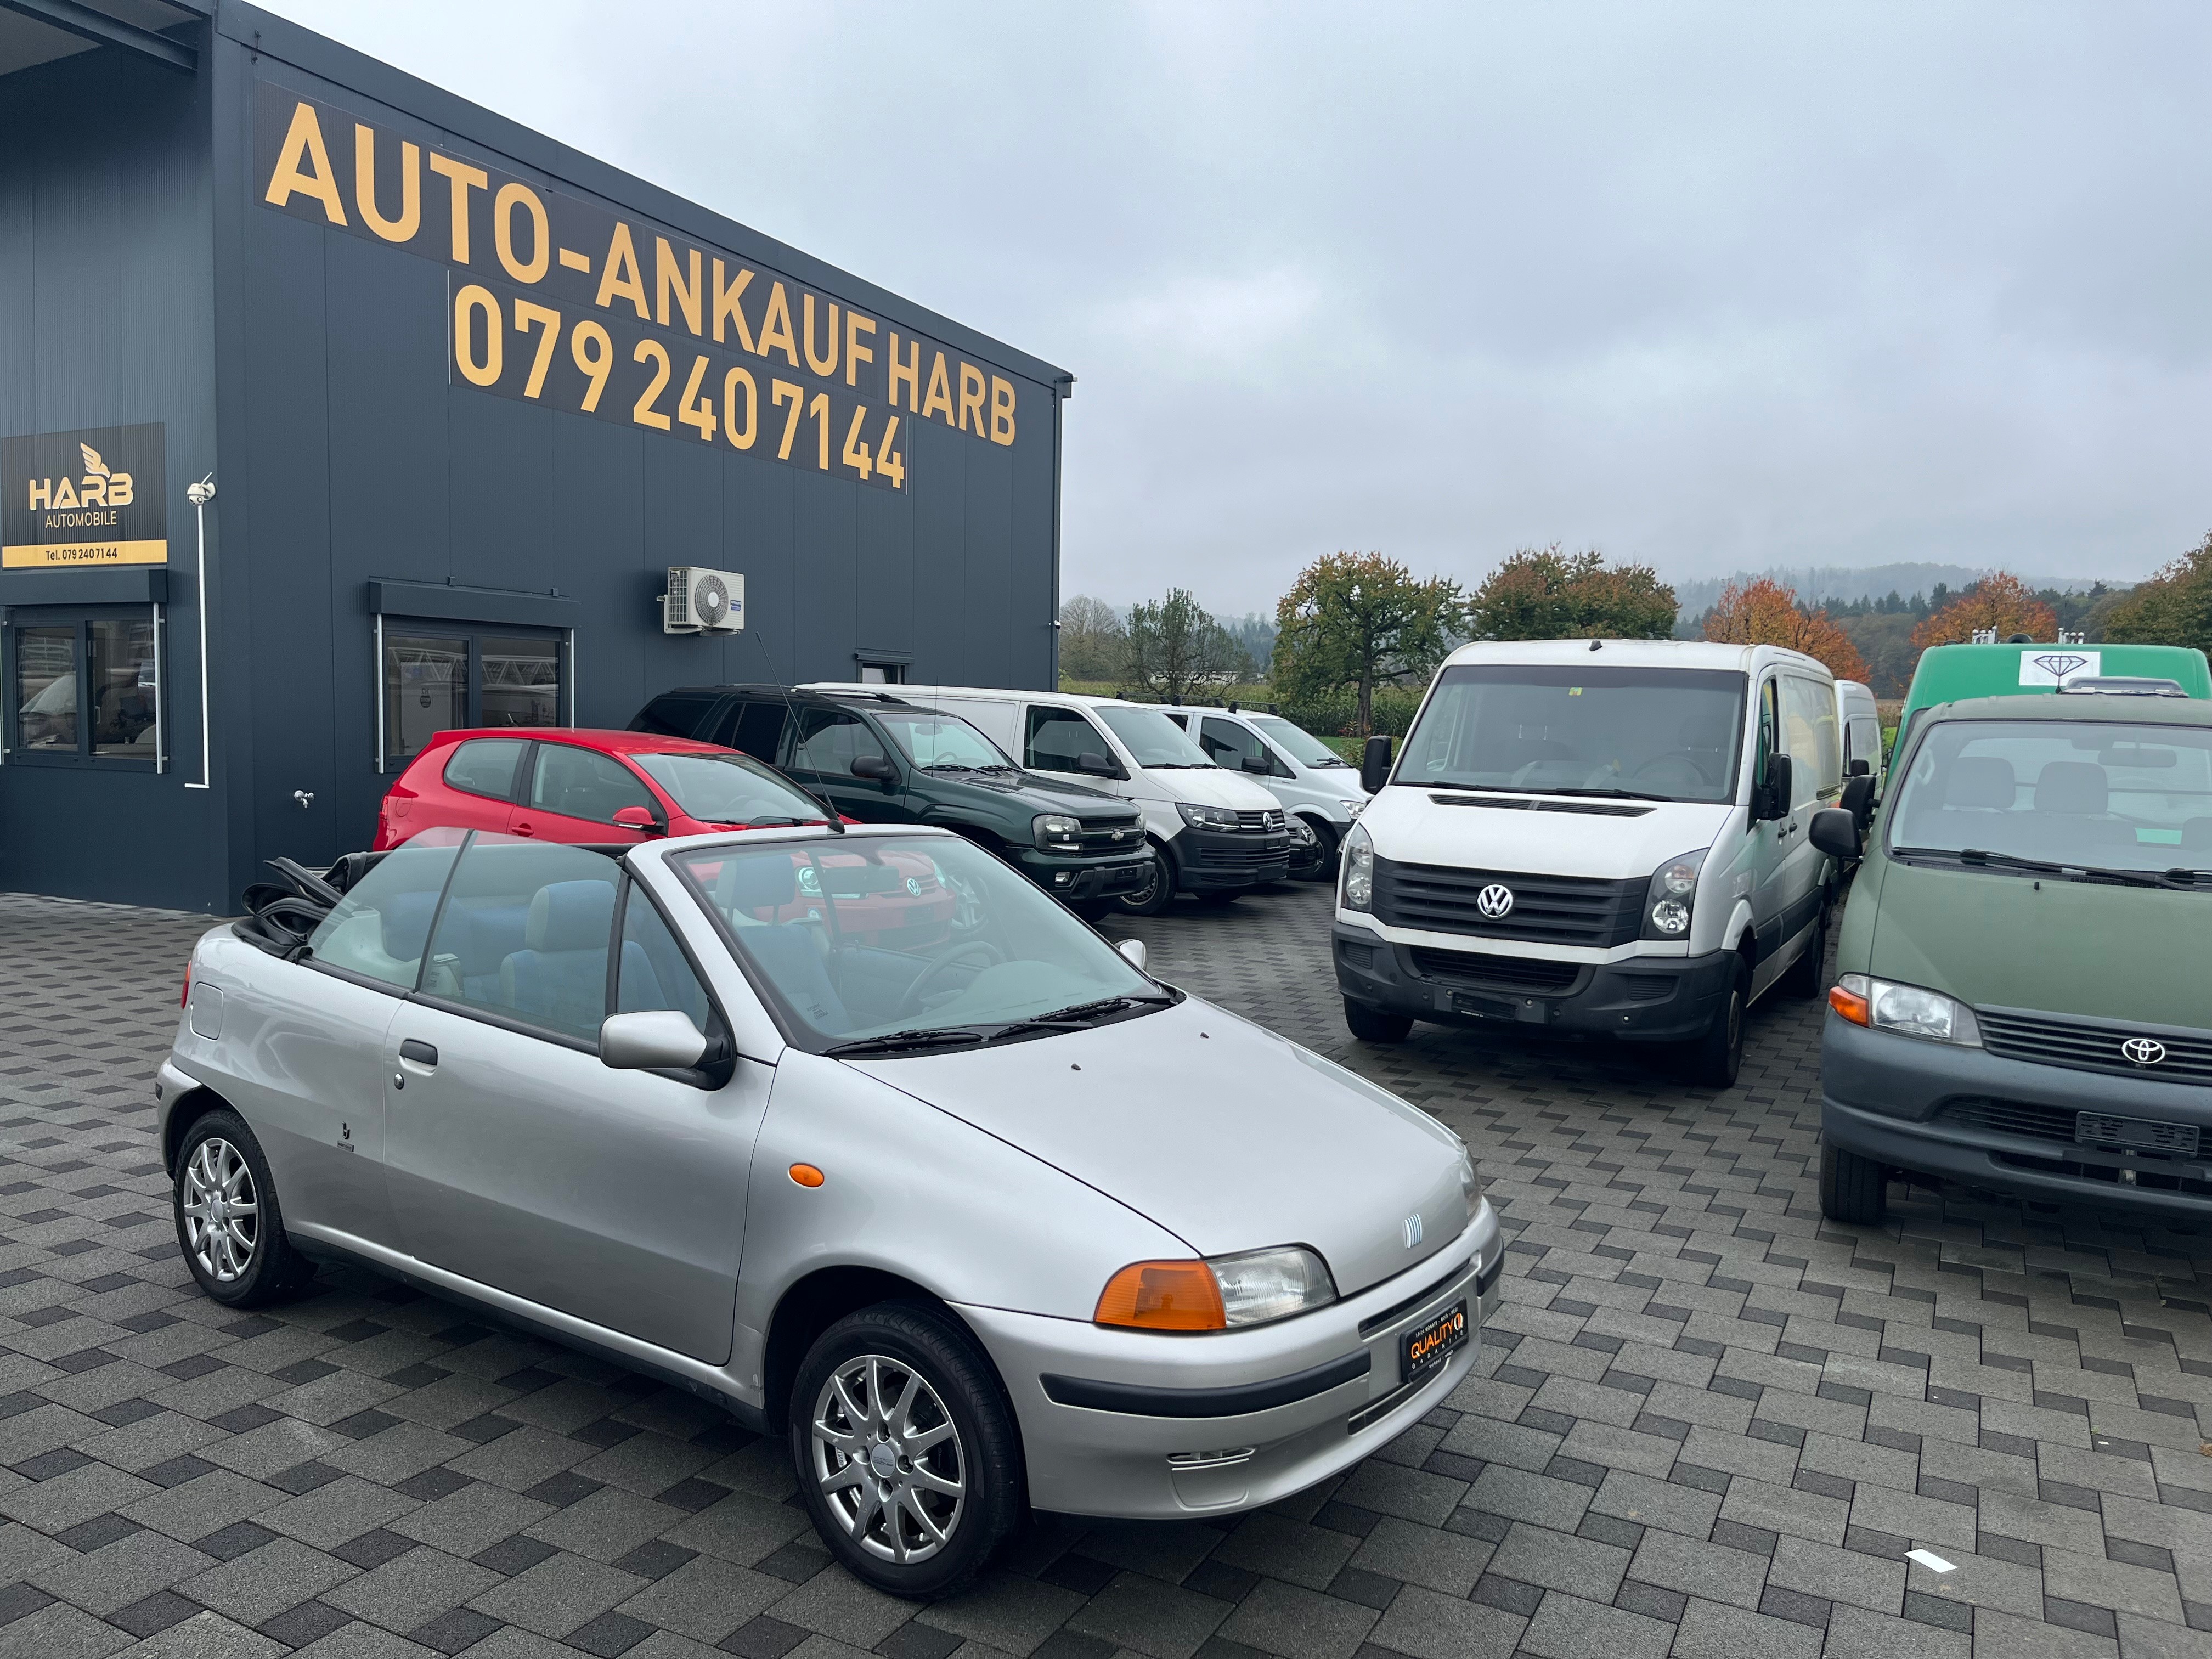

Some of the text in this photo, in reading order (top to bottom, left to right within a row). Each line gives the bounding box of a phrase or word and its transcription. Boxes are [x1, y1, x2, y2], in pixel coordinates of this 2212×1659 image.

[267, 104, 1014, 444] AUTO-ANKAUF HARB
[456, 285, 612, 411] 079
[634, 340, 757, 449] 240
[29, 473, 133, 510] HARB
[46, 511, 117, 528] AUTOMOBILE
[46, 550, 60, 560] Tel.
[63, 549, 77, 560] 079
[79, 548, 94, 559] 240
[1477, 884, 1513, 918] VW
